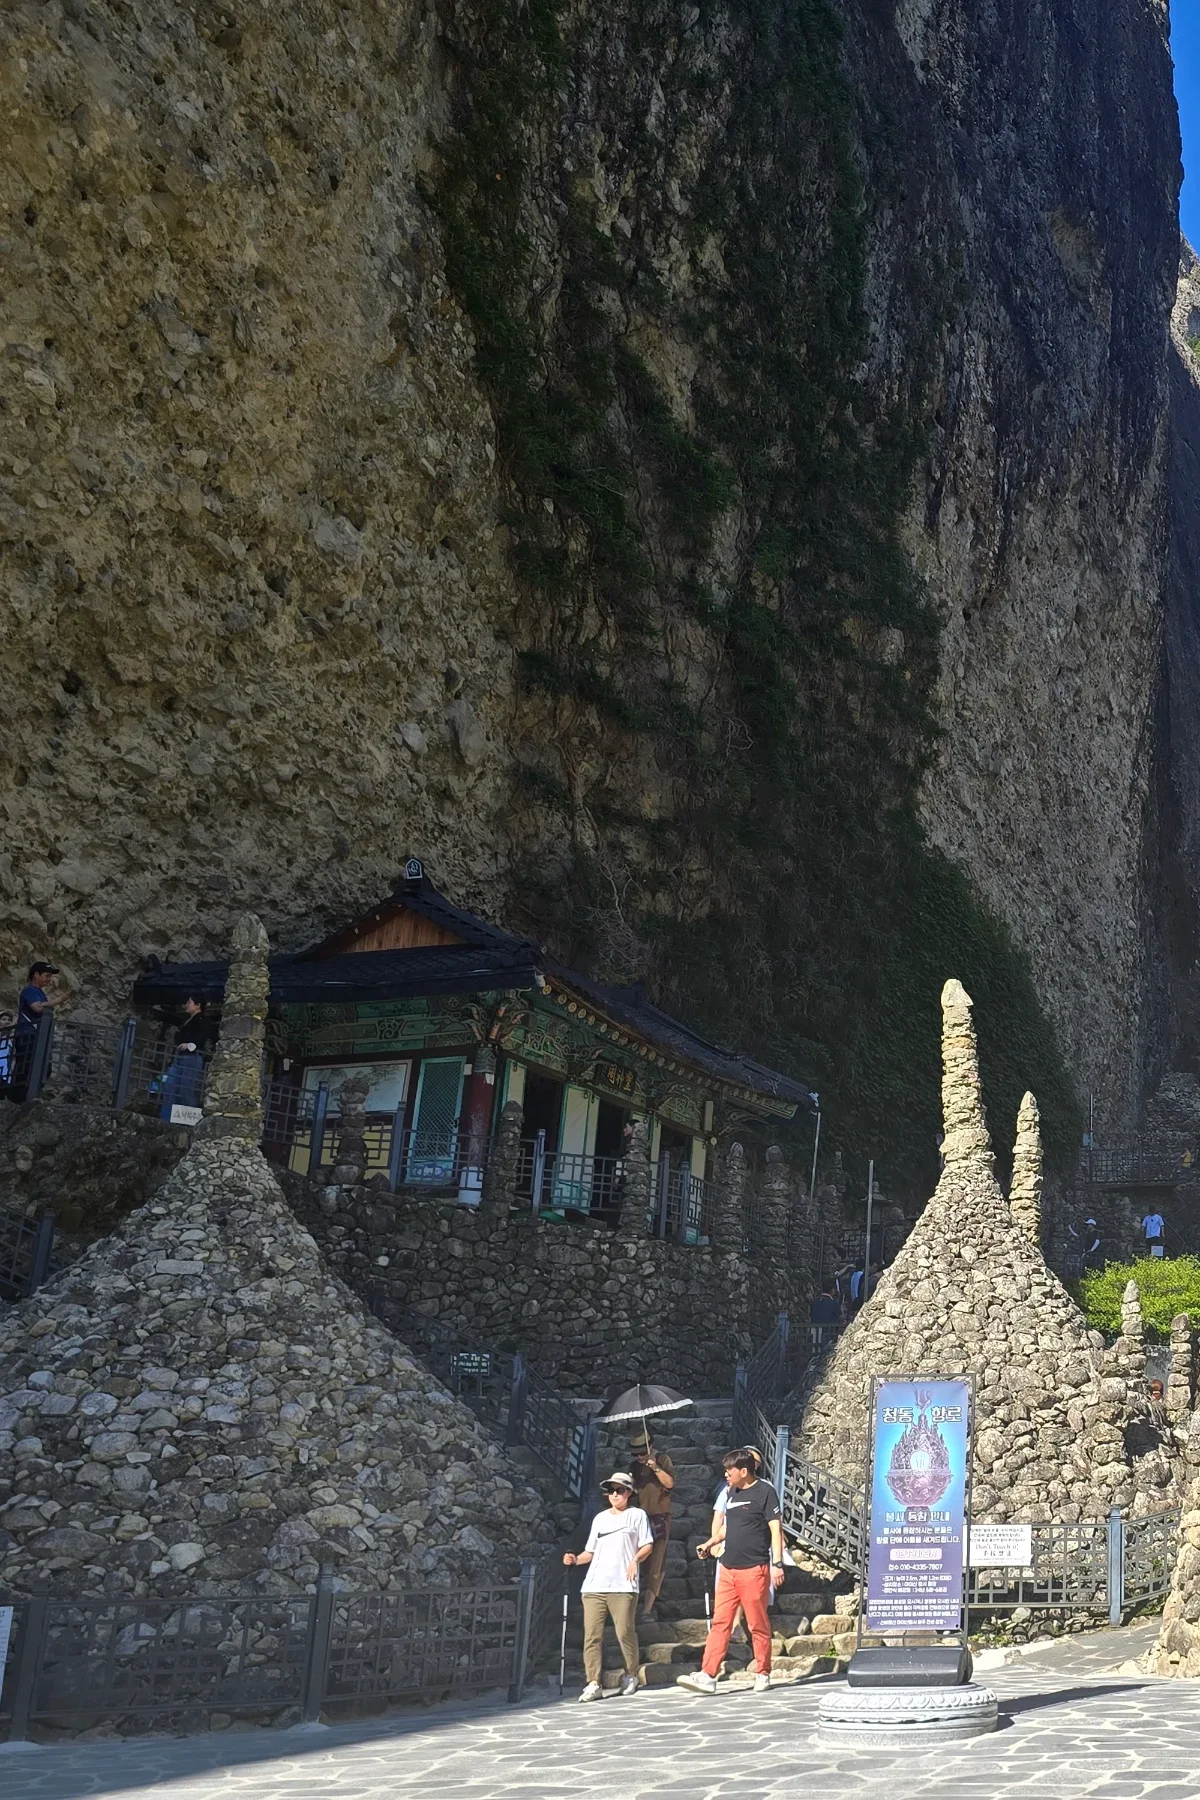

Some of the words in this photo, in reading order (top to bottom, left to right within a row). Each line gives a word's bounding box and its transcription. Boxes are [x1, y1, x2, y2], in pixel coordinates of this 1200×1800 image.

[882, 1406, 914, 1424] 청동
[931, 1405, 962, 1423] 향로
[908, 1511, 927, 1522] 동참
